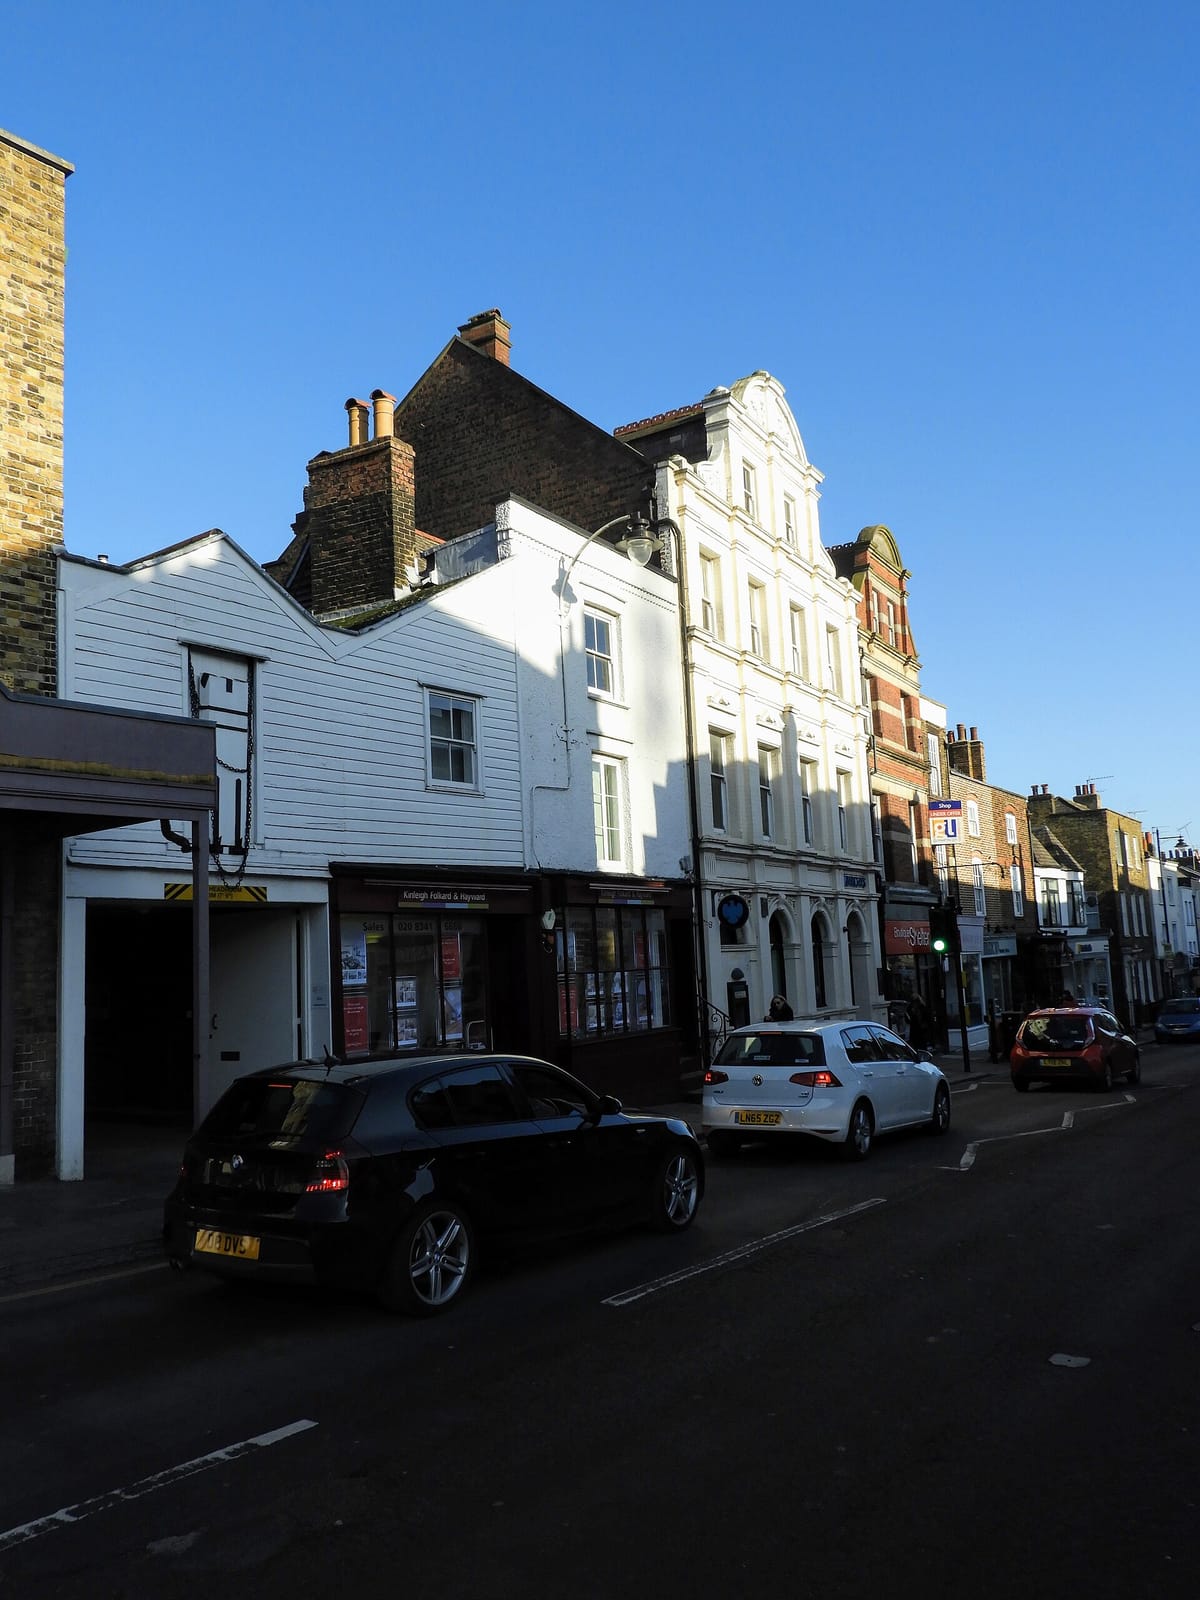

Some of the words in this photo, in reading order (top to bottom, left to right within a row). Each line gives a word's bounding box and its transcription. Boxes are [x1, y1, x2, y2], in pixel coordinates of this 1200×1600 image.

[403, 890, 428, 901] Kinleigh
[430, 891, 452, 900] Folkard
[453, 892, 459, 900] &
[460, 892, 486, 902] Hayward
[362, 921, 384, 931] Sales
[398, 922, 413, 931] 020
[740, 1112, 761, 1123] LN65
